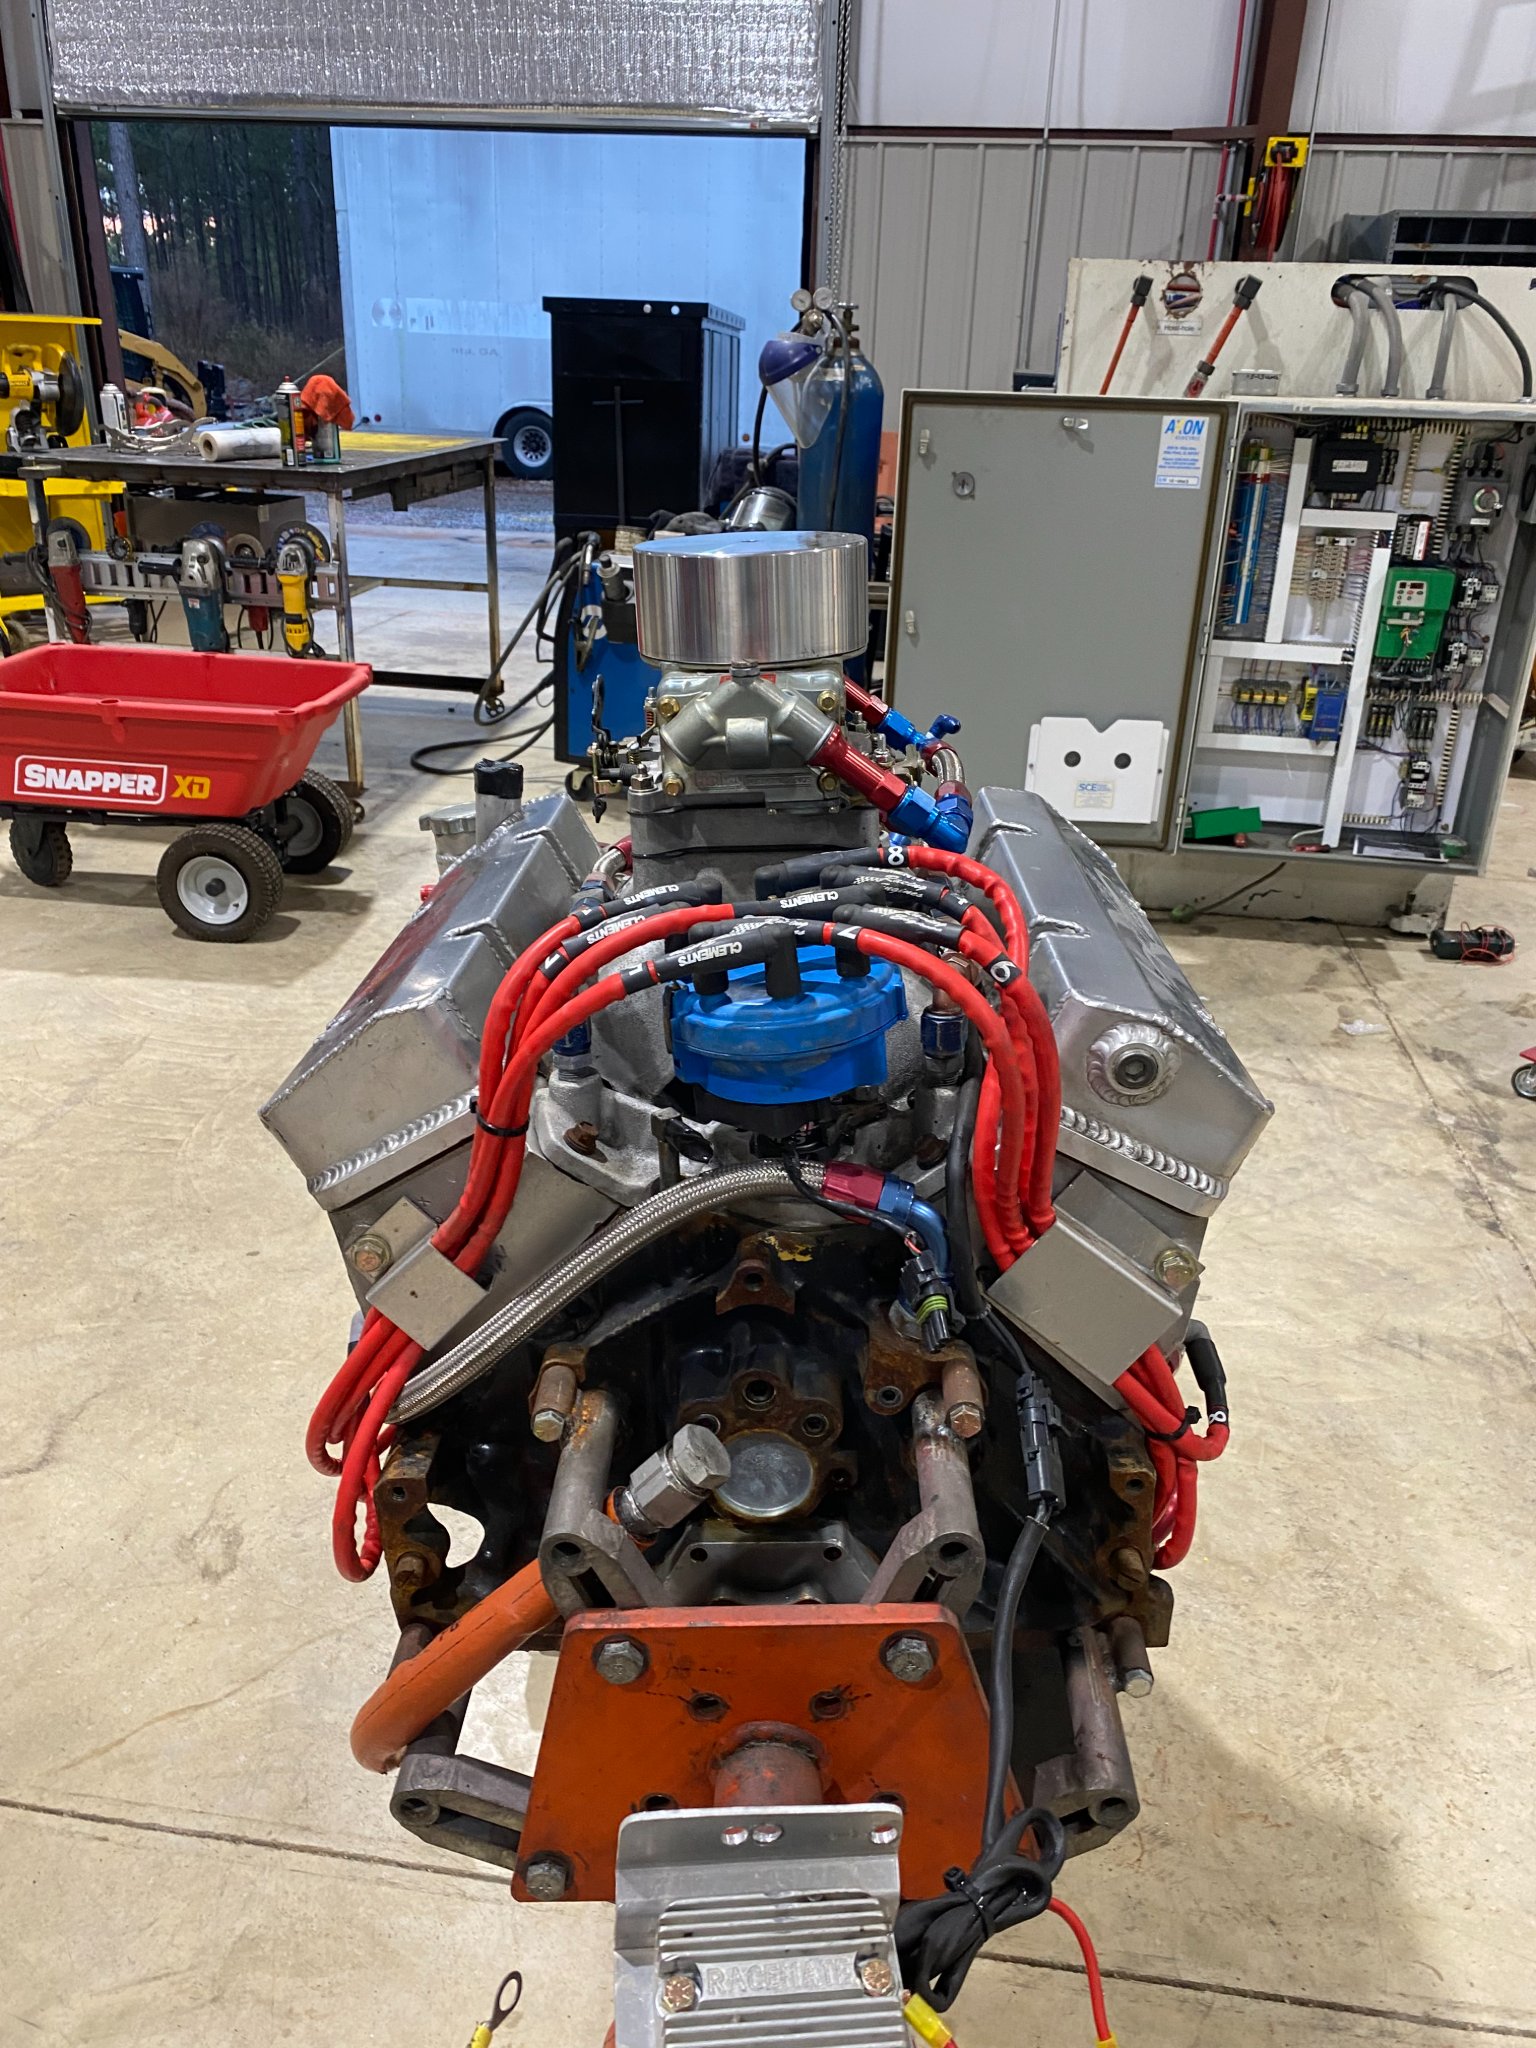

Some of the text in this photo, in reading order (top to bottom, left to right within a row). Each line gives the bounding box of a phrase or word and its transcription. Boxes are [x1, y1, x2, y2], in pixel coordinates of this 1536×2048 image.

[23, 763, 211, 800] SNAPPER XD
[887, 845, 905, 866] 8
[623, 884, 680, 906] CLEMENTS
[779, 889, 840, 909] CLEMENTS
[677, 940, 743, 967] CLEMENTS
[989, 959, 1017, 984] 6
